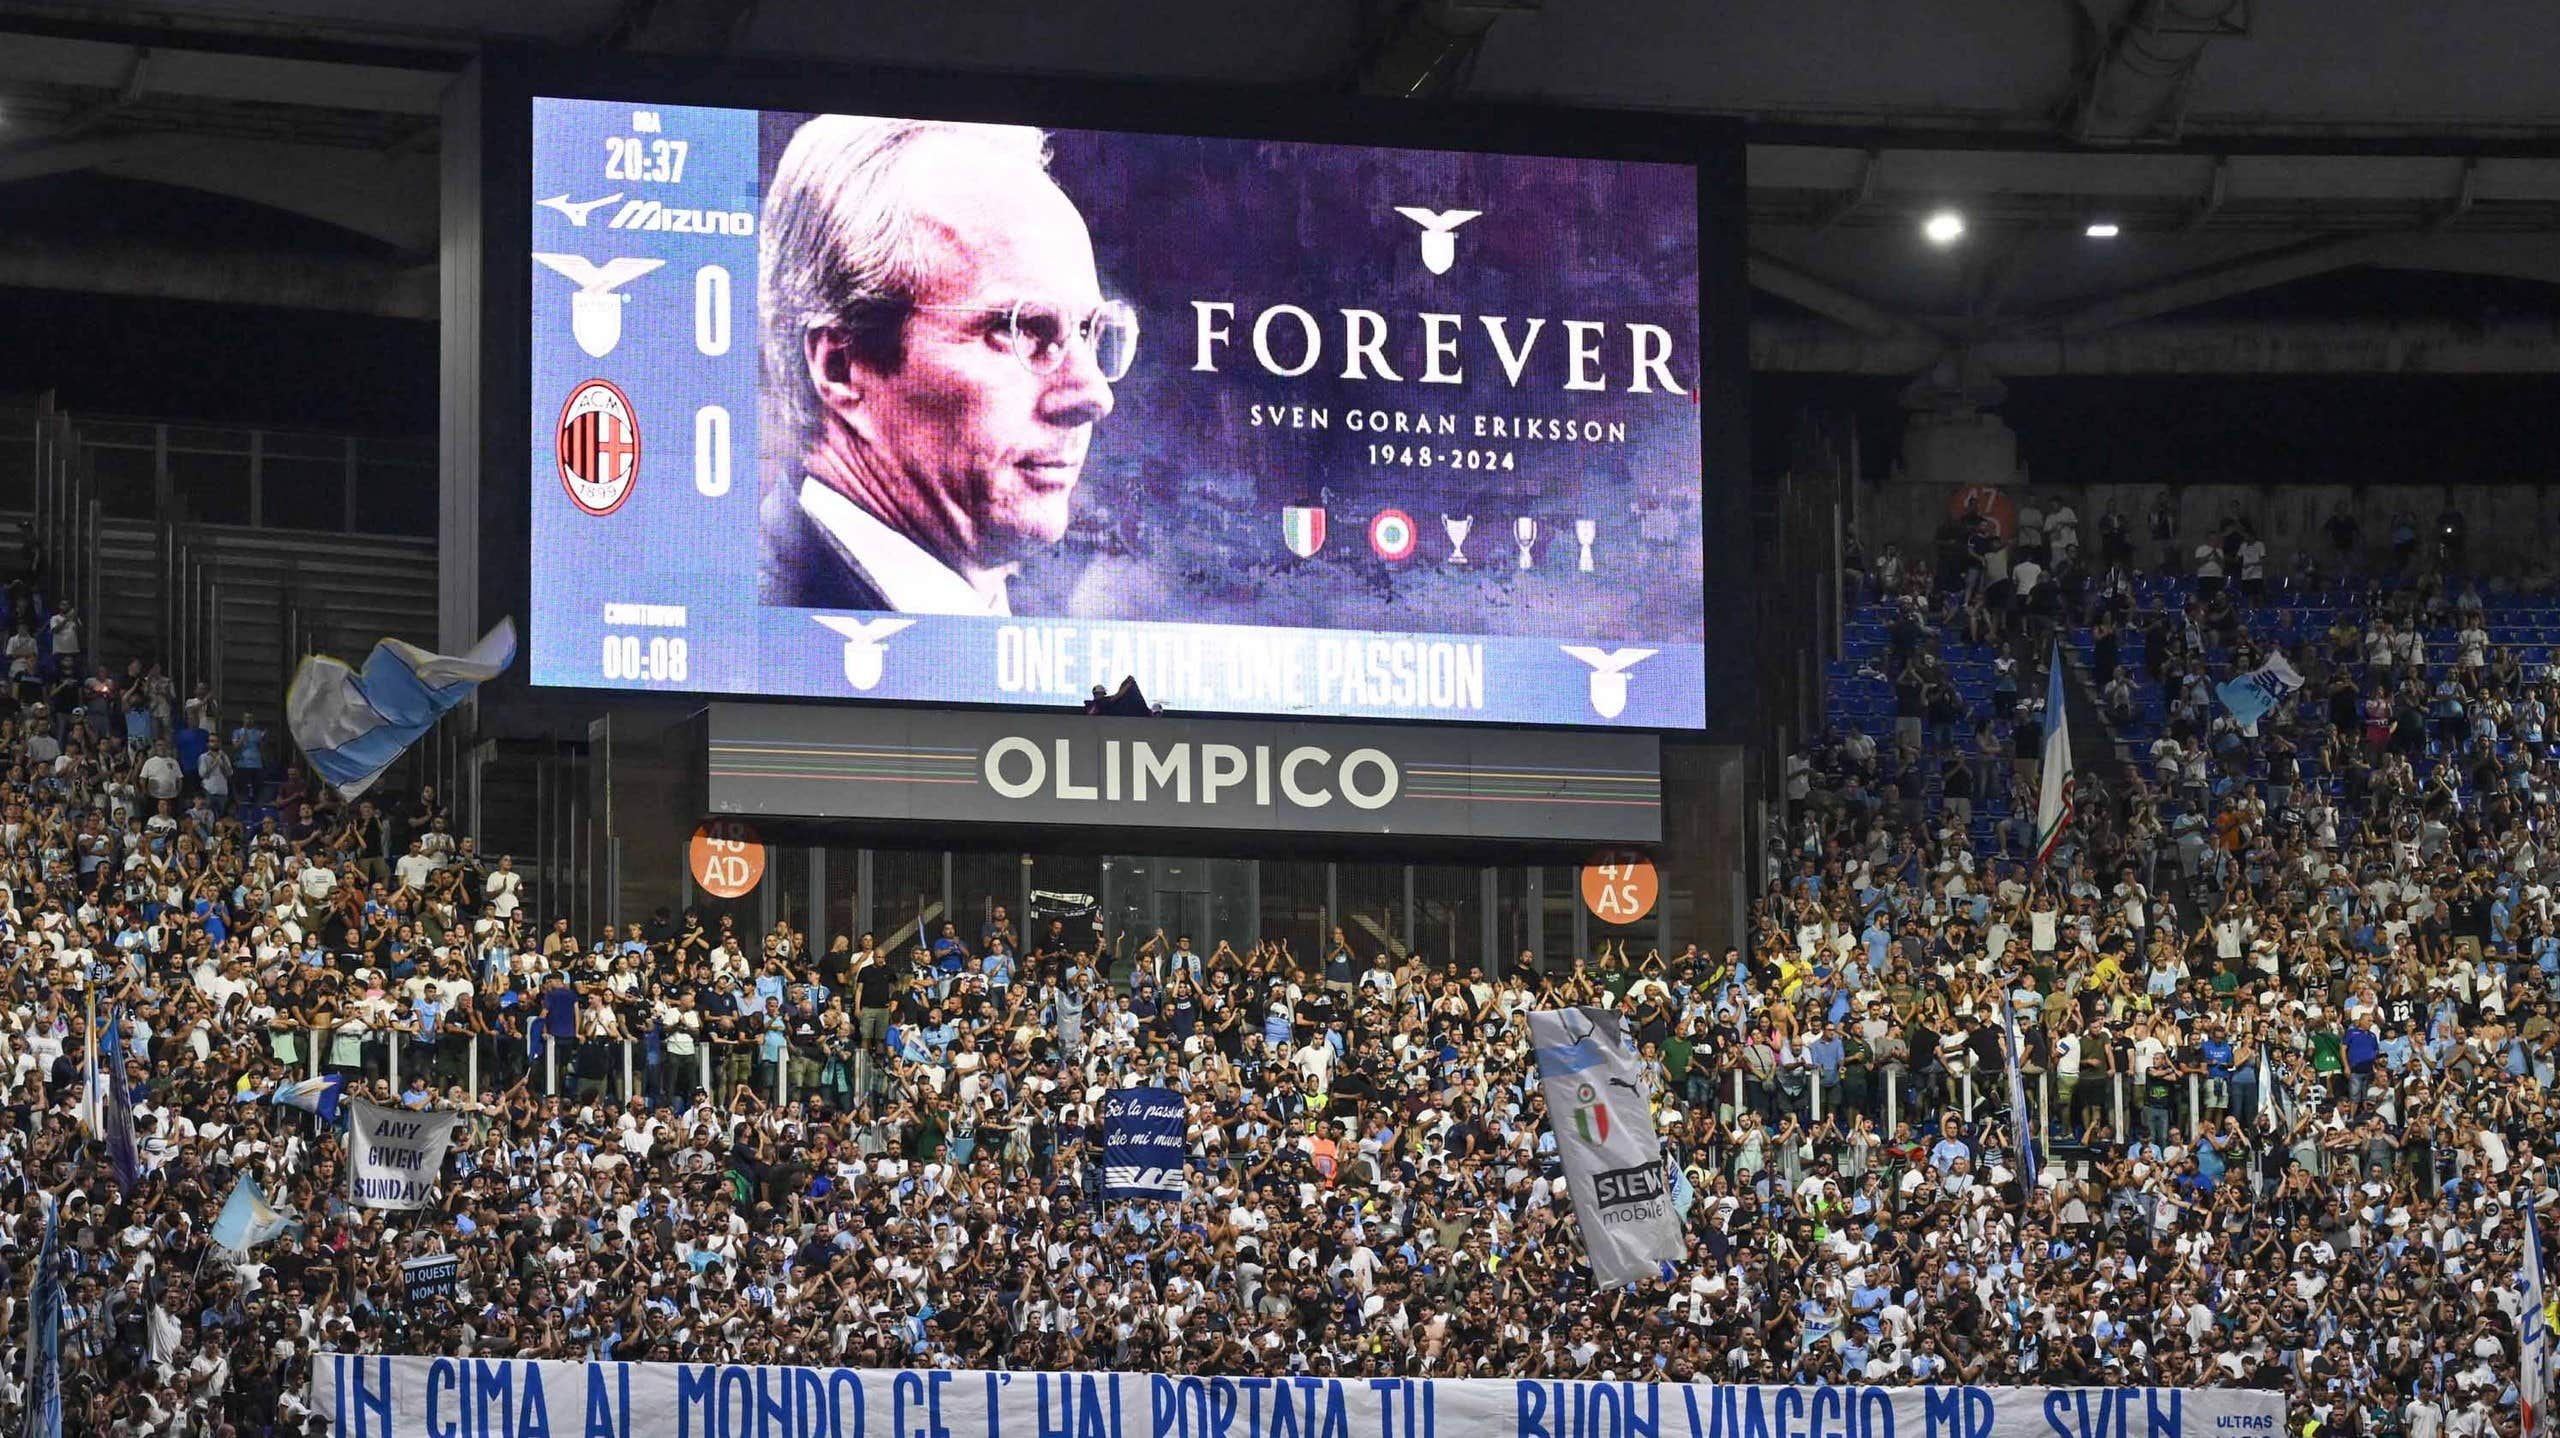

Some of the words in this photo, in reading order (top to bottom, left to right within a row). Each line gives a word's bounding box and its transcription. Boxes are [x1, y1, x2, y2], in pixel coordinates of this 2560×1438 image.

[605, 135, 688, 184] 20:37
[695, 264, 731, 357] 0
[1190, 300, 1688, 395] FOREVER
[1250, 404, 1329, 429] SVEN
[1346, 409, 1457, 435] GORAN
[1474, 415, 1626, 443] ERIKSSON
[695, 405, 731, 498] 0
[1368, 444, 1515, 471] 1948-2024
[602, 634, 688, 681] 00:08
[997, 624, 1078, 693] ONE
[1226, 637, 1305, 703] ONE
[1317, 640, 1485, 709] PASSION
[984, 736, 1400, 810] OLIMPICO
[703, 855, 749, 887] AD
[1597, 884, 1639, 915] AS
[1106, 1099, 1125, 1118] Sei
[1128, 1098, 1142, 1116] la
[374, 1119, 423, 1140] ANY
[1131, 1130, 1151, 1146] mi
[368, 1145, 424, 1171] GIVEN
[353, 1177, 433, 1201] SUNDAY
[404, 1270, 416, 1284] DI
[411, 1285, 435, 1301] NON
[426, 1357, 551, 1438] CIMA
[677, 1364, 865, 1438] MONDO
[1151, 1374, 1349, 1438] PORTATA
[2216, 1414, 2273, 1430] ULTRAS
